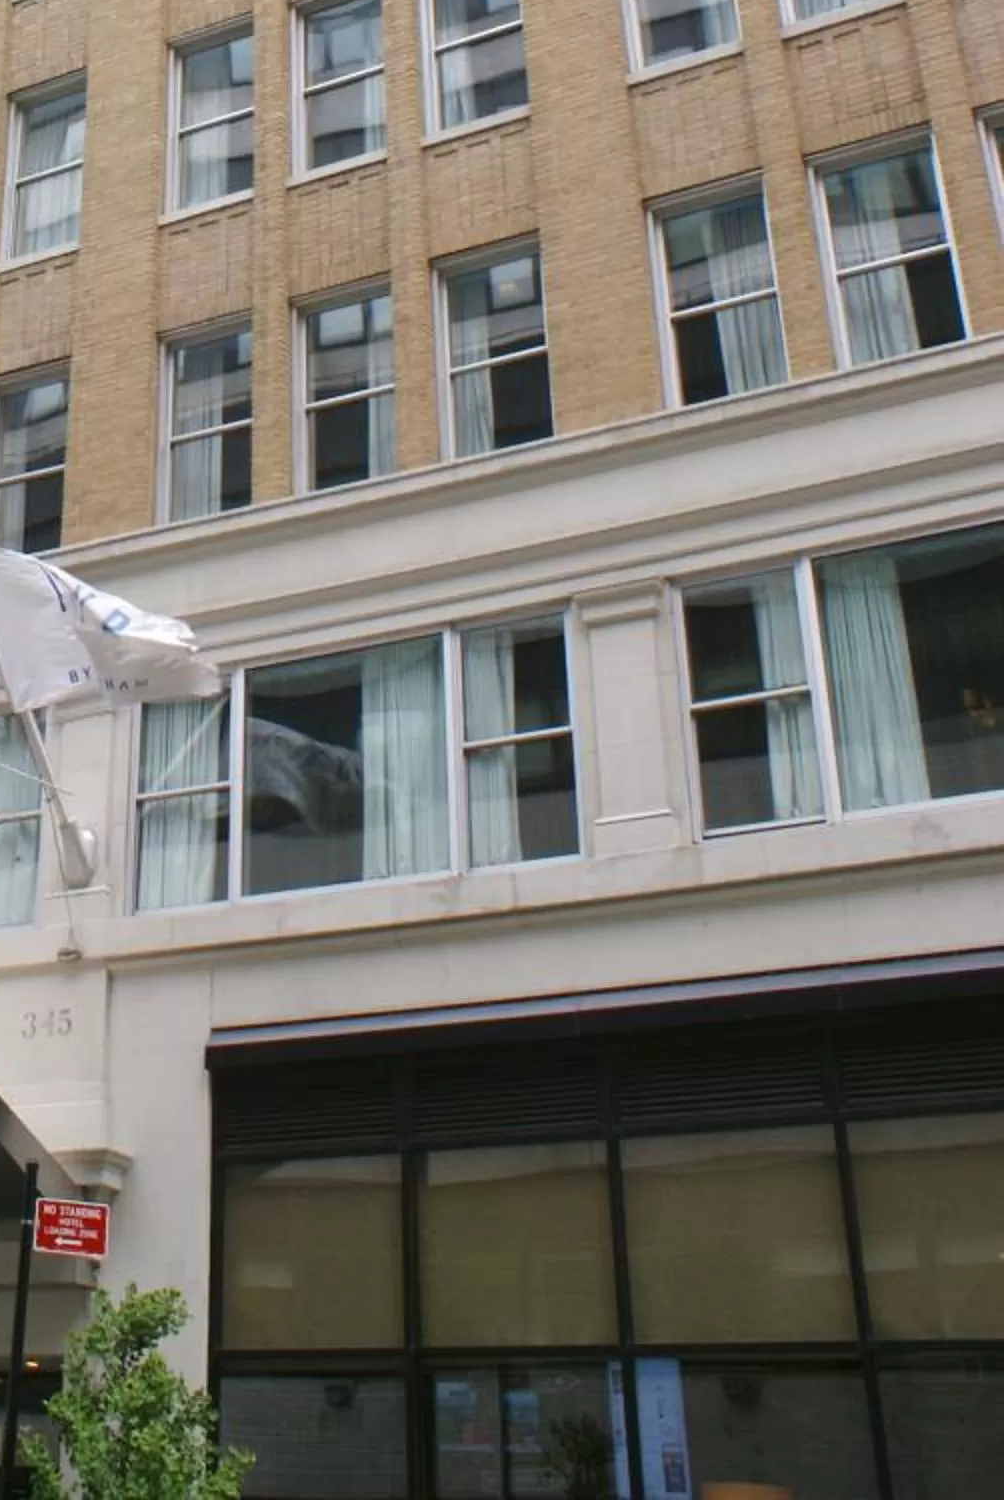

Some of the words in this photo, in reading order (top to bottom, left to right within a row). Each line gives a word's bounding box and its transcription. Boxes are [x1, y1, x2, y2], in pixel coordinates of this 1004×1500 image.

[68, 666, 92, 684] BY
[21, 1007, 73, 1039] 345
[43, 1204, 57, 1215] NO
[59, 1205, 101, 1219] STANDING
